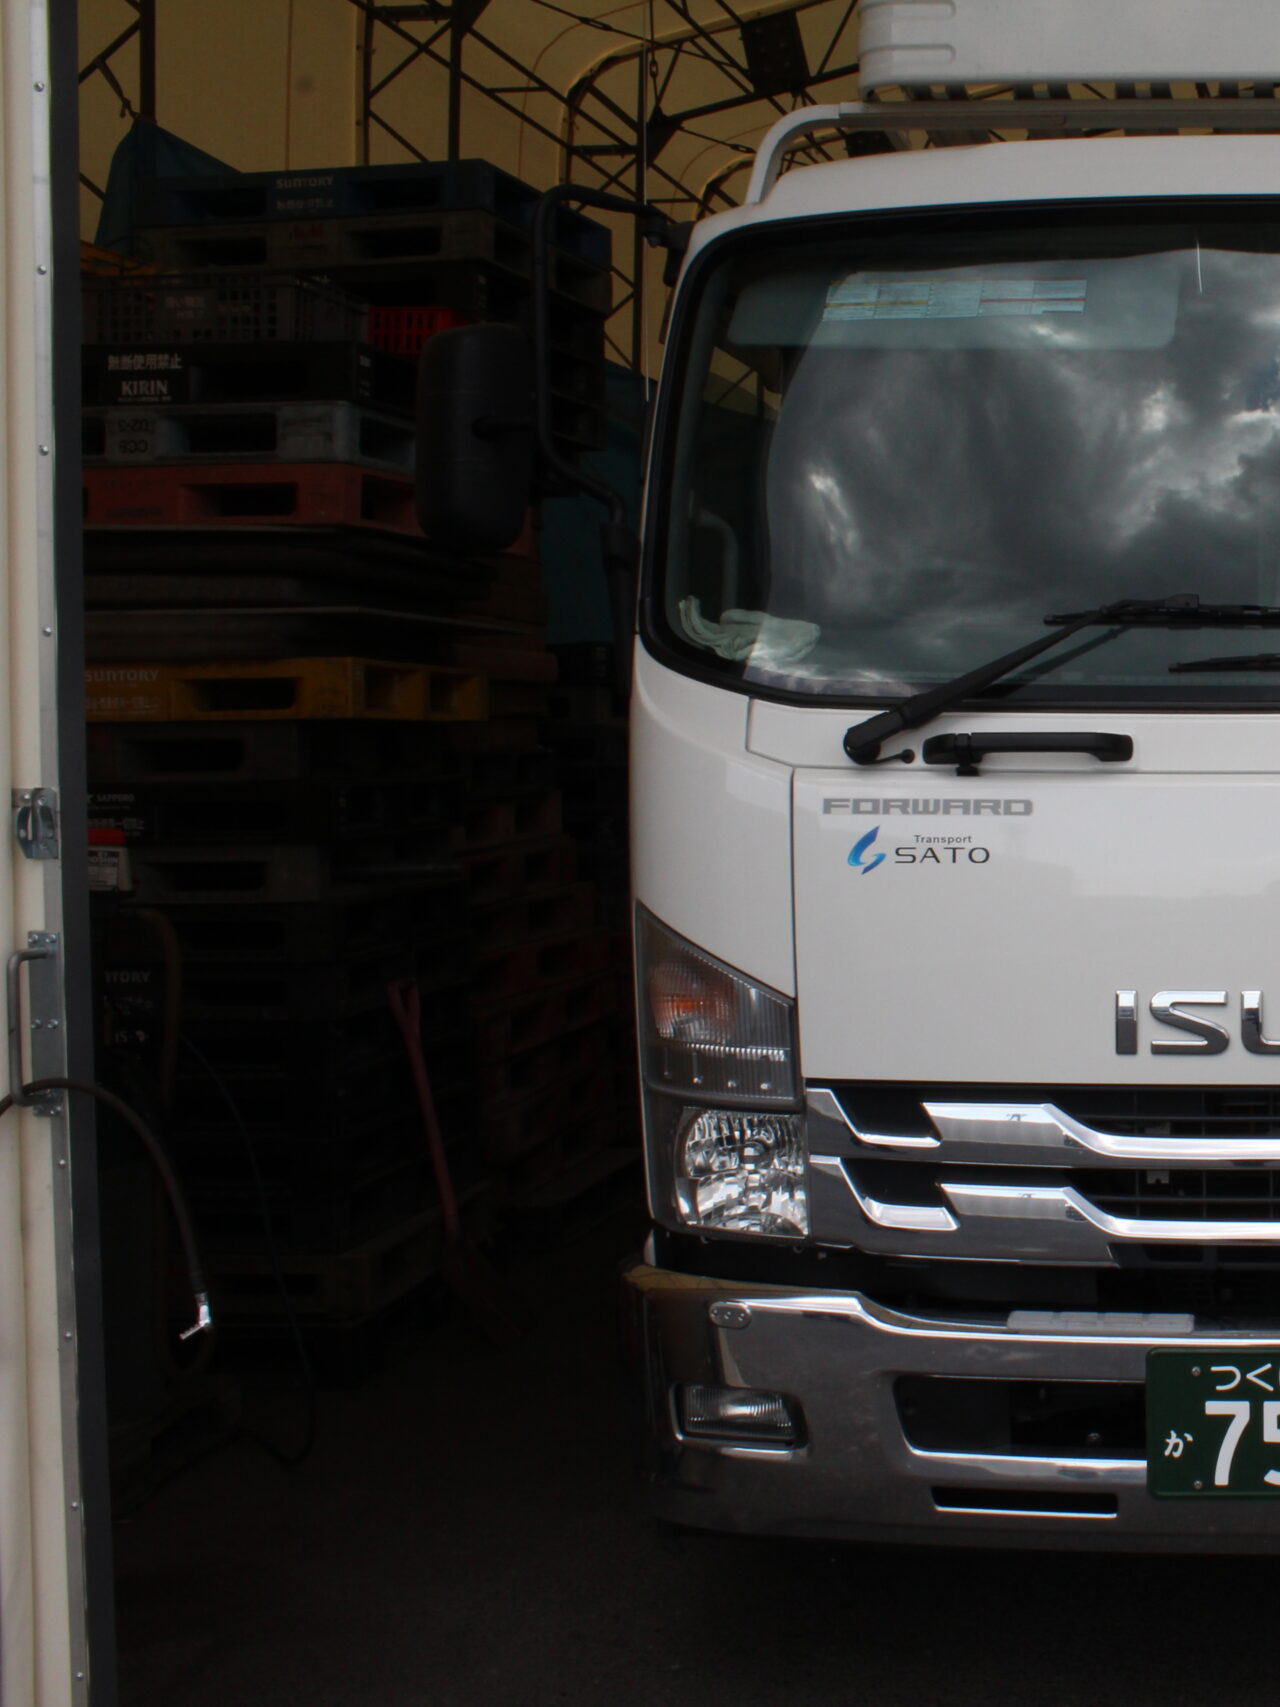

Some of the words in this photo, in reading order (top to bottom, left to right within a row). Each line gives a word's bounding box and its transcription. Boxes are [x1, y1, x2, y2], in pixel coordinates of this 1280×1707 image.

[275, 175, 334, 189] SUNTORY
[120, 379, 169, 396] KIRIN
[84, 669, 160, 683] SUNTORY
[822, 798, 1033, 816] FORWARD
[913, 834, 972, 845] Transport
[894, 847, 990, 864] SATO
[1162, 1429, 1194, 1458] か
